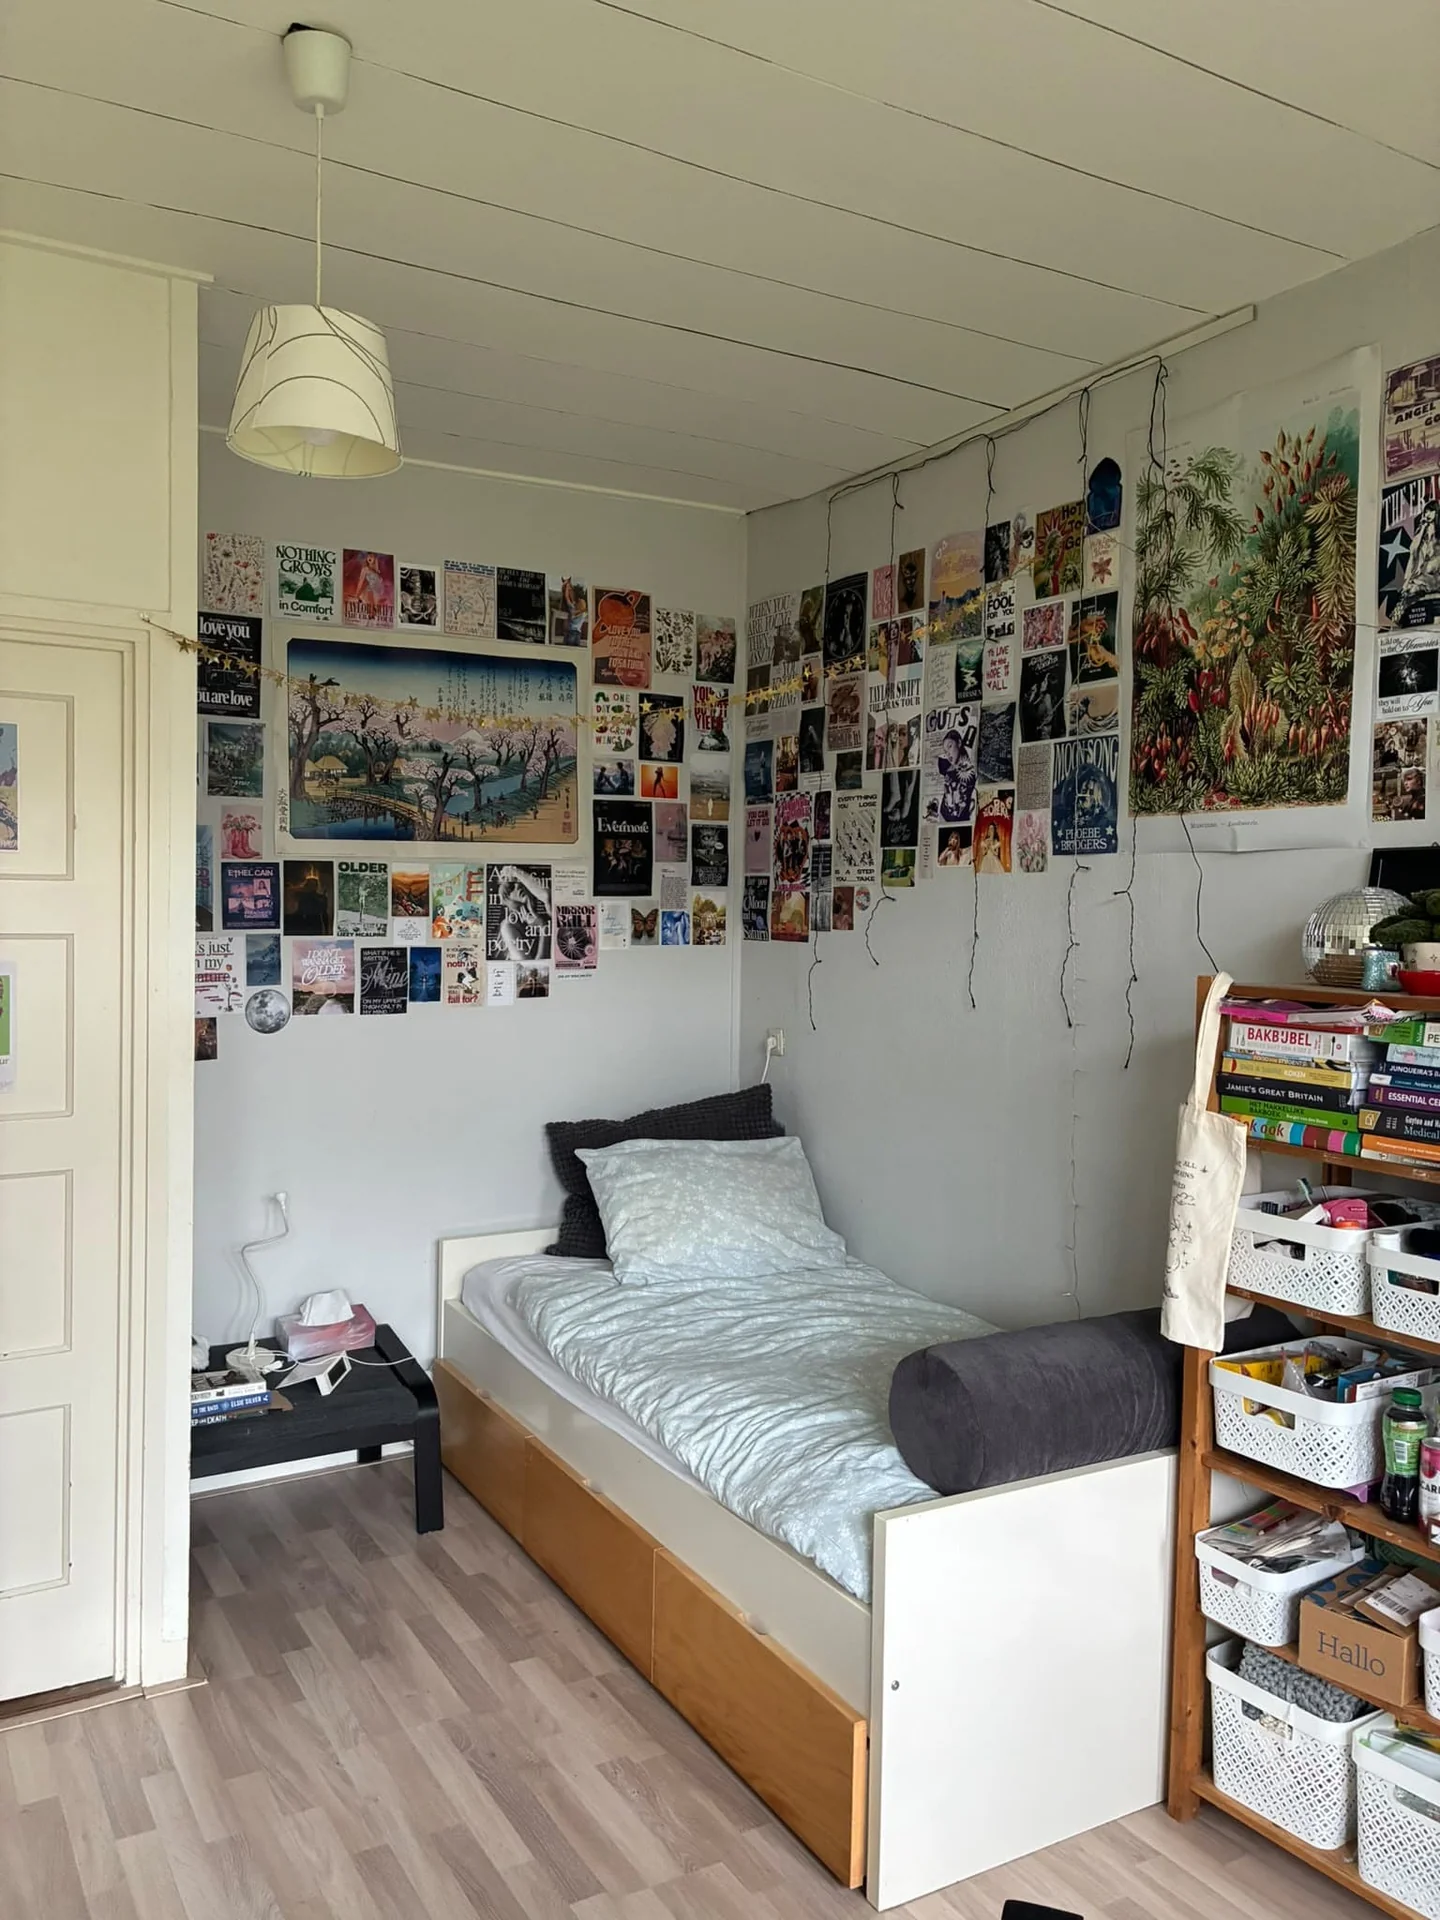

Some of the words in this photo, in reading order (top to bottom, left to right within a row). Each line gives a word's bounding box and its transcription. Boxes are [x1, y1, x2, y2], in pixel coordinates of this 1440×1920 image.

[1395, 403, 1436, 425] ANGEL
[1382, 487, 1406, 531] THE
[1407, 475, 1440, 518] ERA
[276, 545, 336, 564] NOTHING
[280, 560, 332, 577] GROWS
[279, 600, 288, 610] in
[290, 601, 334, 616] Comfort
[749, 600, 771, 619] WHEN
[774, 594, 791, 612] YOU
[987, 596, 1014, 612] FOOL
[987, 611, 998, 620] FOR
[1002, 608, 1014, 617] YOU
[199, 616, 226, 636] love
[226, 624, 250, 640] you
[748, 617, 765, 636] ARE
[766, 609, 792, 632] YOUNG
[749, 632, 769, 653] THEY
[996, 646, 1009, 656] LIVE
[870, 682, 896, 704] TAYLOR
[896, 678, 921, 700] SWIFT
[993, 679, 1008, 691] ALL
[198, 690, 210, 702] ou
[211, 692, 230, 704] are
[230, 690, 253, 706] love
[614, 693, 630, 703] ONE
[901, 696, 921, 708] TOUR
[926, 706, 971, 732] GUTS
[838, 794, 878, 803] EVERYTHING
[597, 816, 650, 834] Evermore
[1065, 827, 1102, 840] PHOEBE
[1061, 838, 1108, 851] BRIDGERS
[254, 869, 274, 877] CAIN
[338, 861, 388, 874] OLDER
[489, 888, 503, 905] in
[556, 906, 596, 915] MIRROR
[524, 919, 552, 937] and
[208, 941, 231, 957] just
[204, 958, 224, 972] my
[448, 995, 460, 1004] fall
[462, 994, 479, 1004] for?
[1389, 1064, 1434, 1077] JUNQUEIRA'S
[1225, 1082, 1257, 1094] JAMIE'S
[1258, 1086, 1286, 1098] GREAT
[1288, 1090, 1324, 1103] BRITAIN
[1388, 1092, 1428, 1106] ESSENTIAL
[1405, 1115, 1422, 1126] Guyton
[1424, 1118, 1434, 1128] and
[1260, 1123, 1285, 1137] ook
[1404, 1126, 1440, 1140] Medical
[230, 1399, 244, 1408] ELSIE
[245, 1396, 262, 1406] SILVER
[207, 1414, 227, 1424] DEATH
[1318, 1631, 1385, 1677] Hallo
